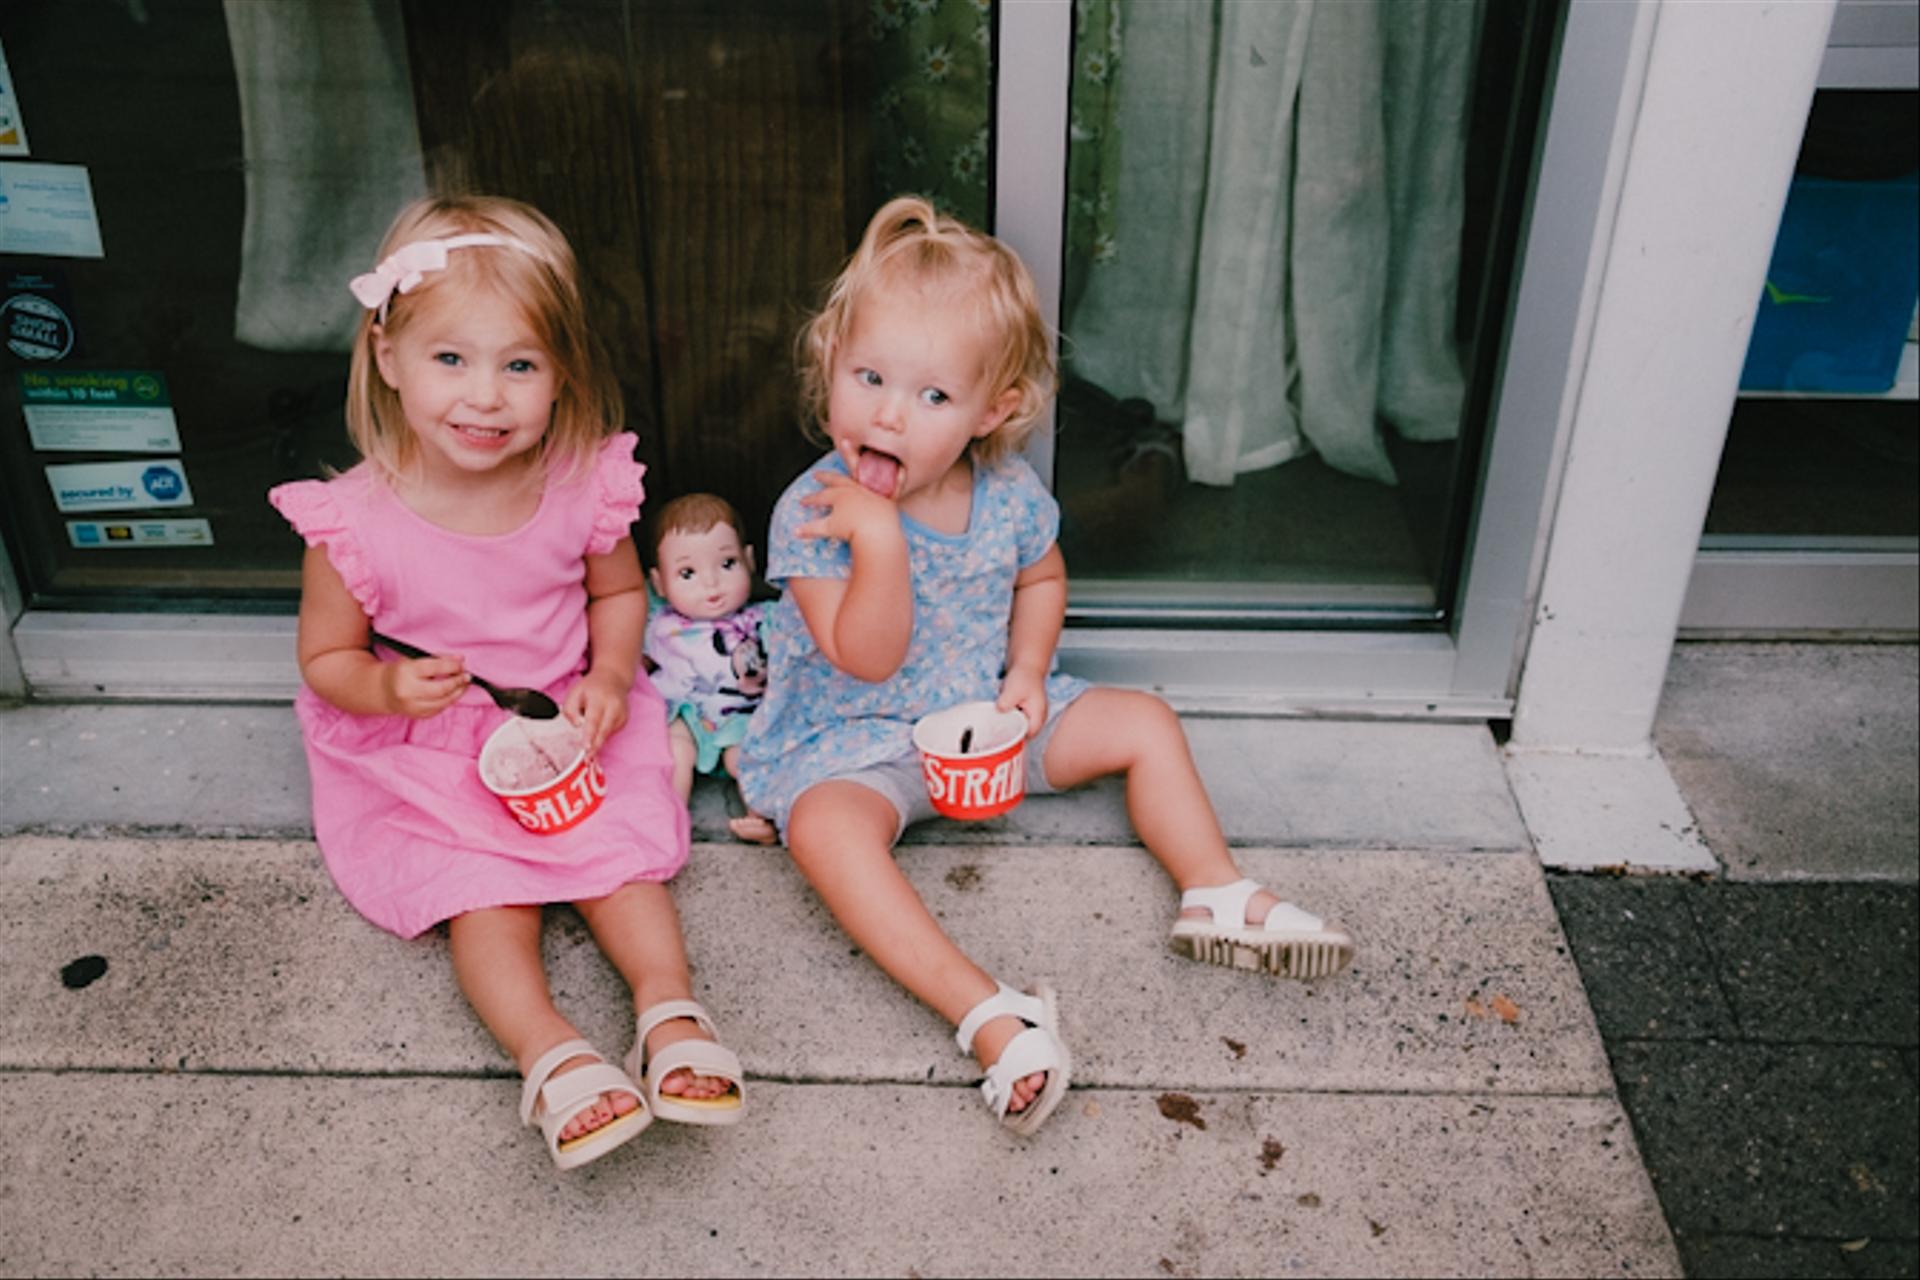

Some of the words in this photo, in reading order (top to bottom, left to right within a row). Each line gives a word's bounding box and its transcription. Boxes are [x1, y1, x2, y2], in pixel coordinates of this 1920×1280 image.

[23, 373, 49, 387] No
[55, 373, 129, 392] smoking
[26, 387, 69, 399] within
[71, 387, 87, 400] 10
[90, 387, 117, 399] feet
[60, 486, 114, 499] secured
[118, 485, 134, 499] by
